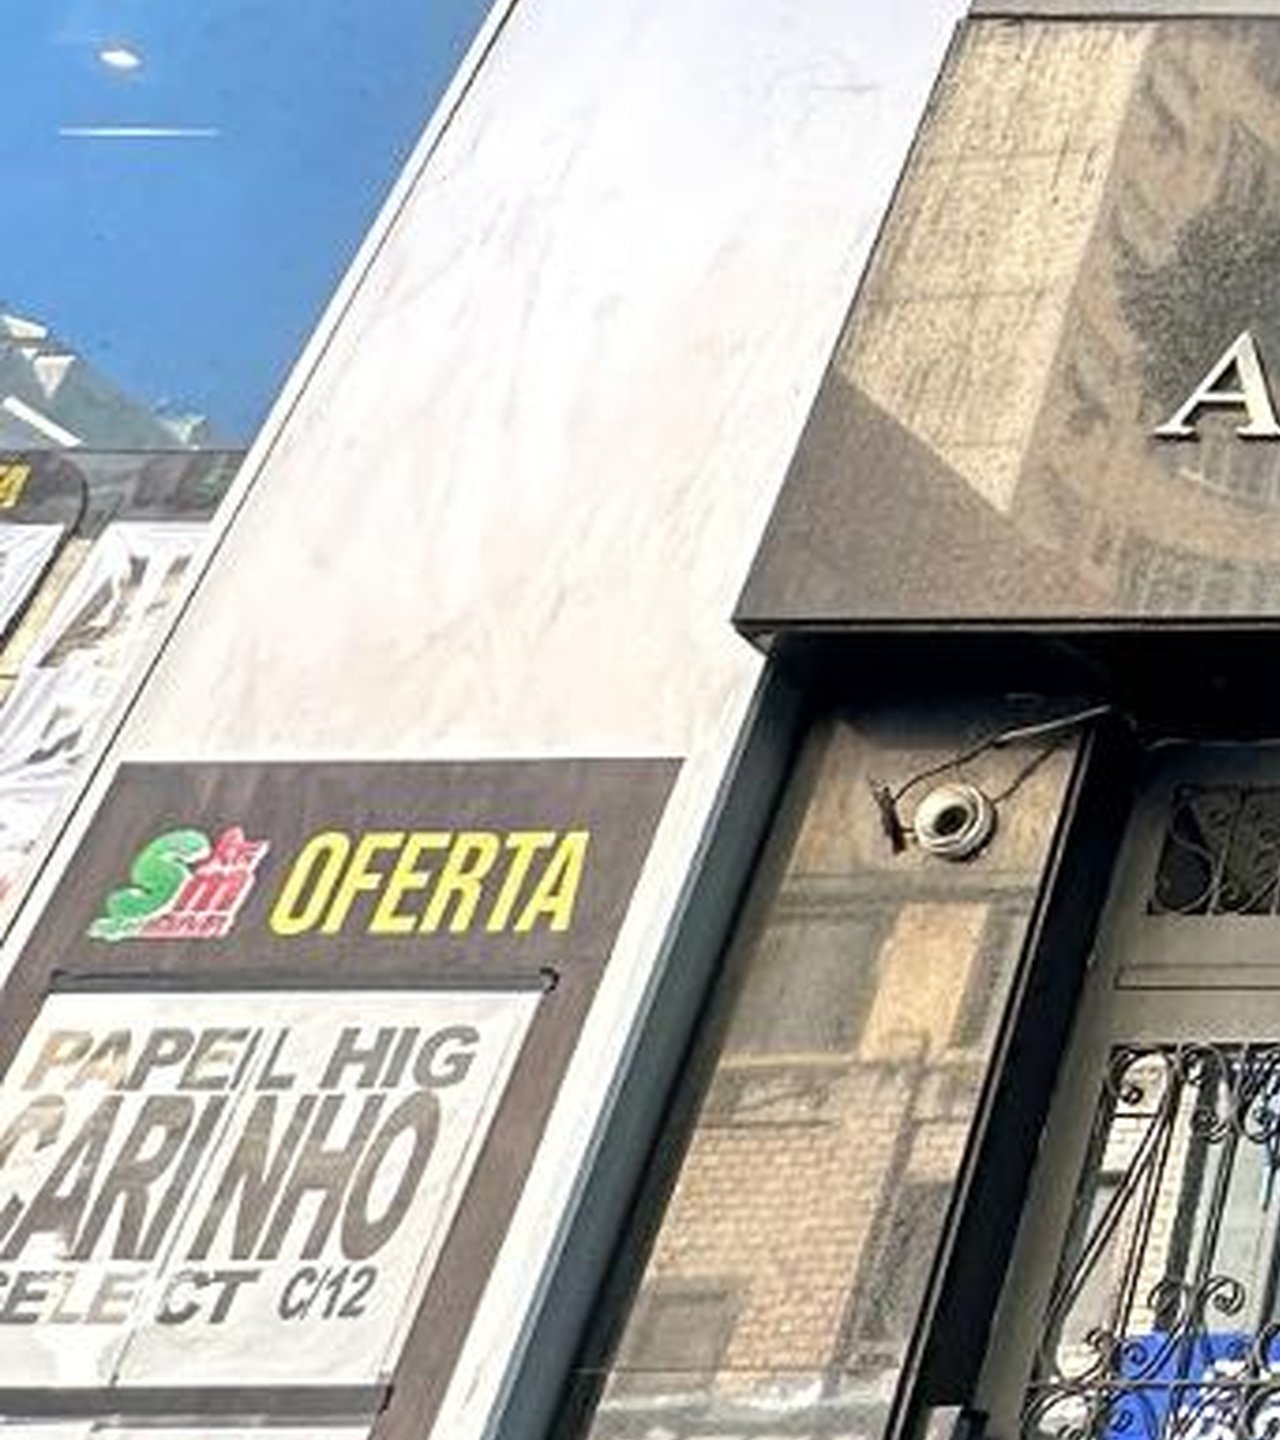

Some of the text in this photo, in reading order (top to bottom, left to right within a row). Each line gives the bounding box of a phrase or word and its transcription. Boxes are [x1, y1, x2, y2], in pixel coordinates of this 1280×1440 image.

[270, 831, 590, 935] OFERTA
[22, 1025, 481, 1091] PAPEL HIG
[0, 1265, 379, 1324] ELECT C/12
